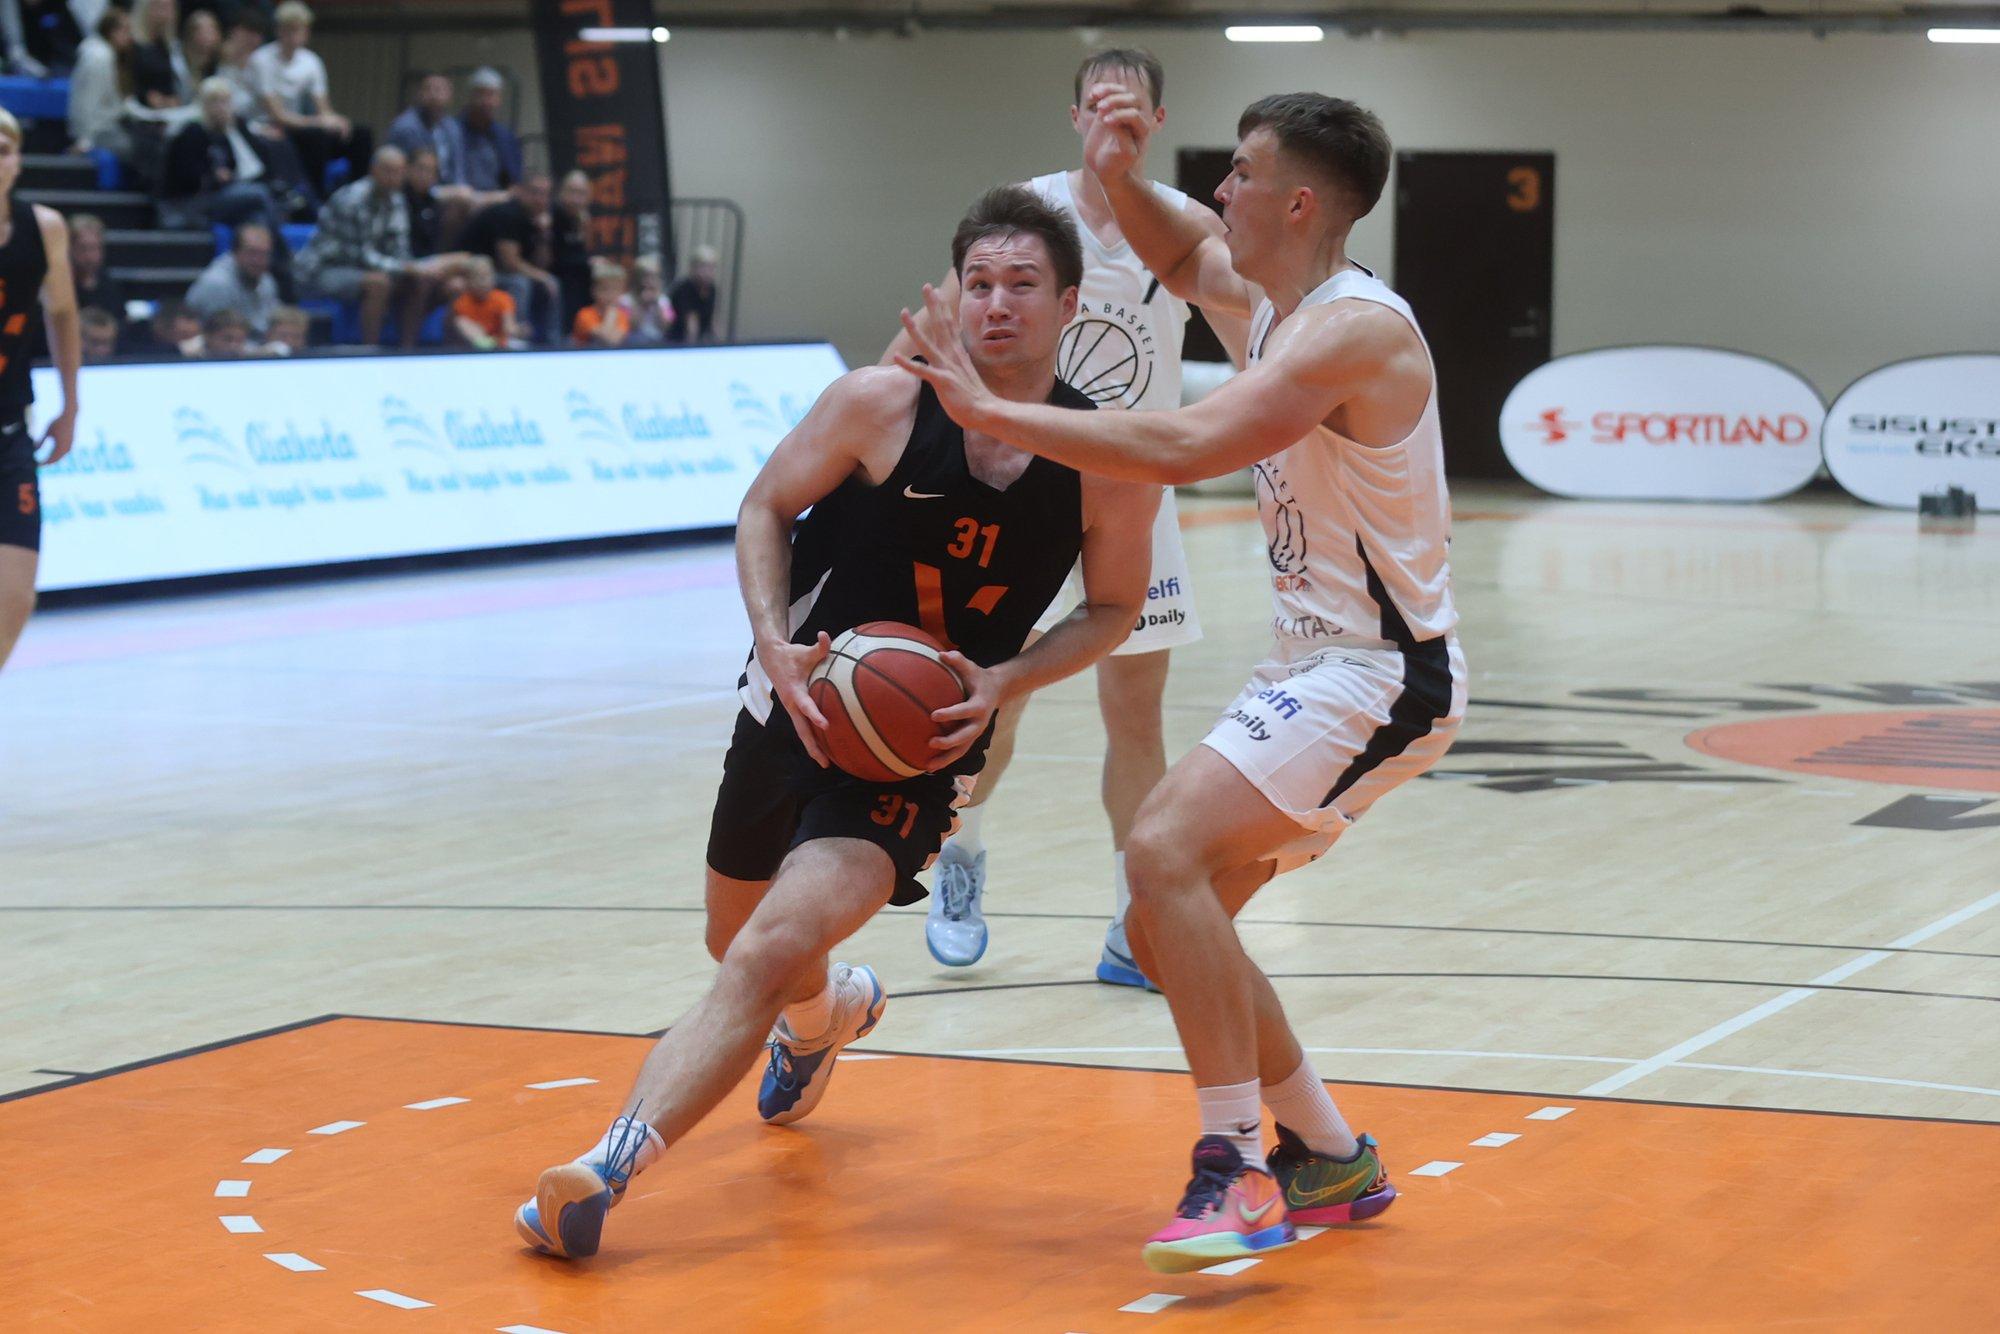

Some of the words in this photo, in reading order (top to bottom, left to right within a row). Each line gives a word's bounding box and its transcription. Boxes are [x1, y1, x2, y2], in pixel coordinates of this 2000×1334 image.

[1508, 167, 1539, 211] 3
[1104, 303, 1155, 355] BASKET
[1592, 413, 1809, 443] SPORTLAND
[947, 517, 1000, 568] 31
[1147, 576, 1181, 600] elfi
[1148, 608, 1186, 626] Daily
[1258, 689, 1303, 720] elfi
[871, 794, 920, 839] 31
